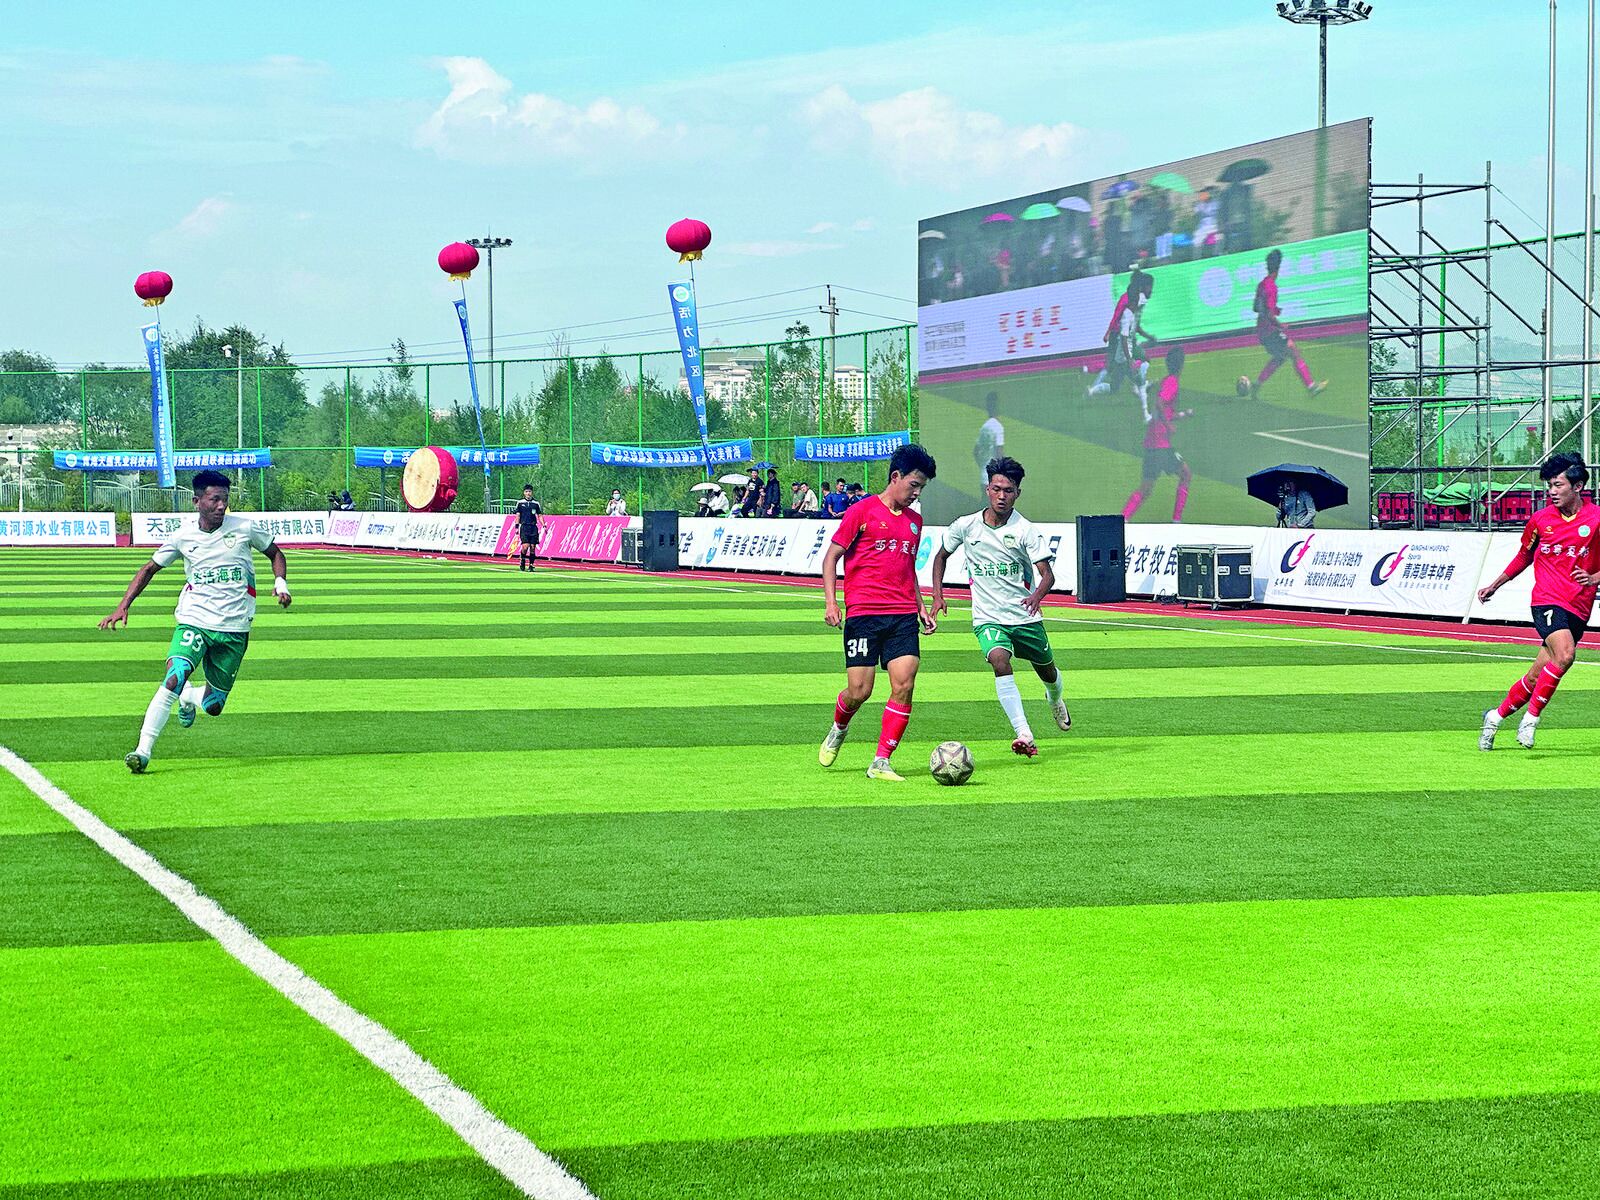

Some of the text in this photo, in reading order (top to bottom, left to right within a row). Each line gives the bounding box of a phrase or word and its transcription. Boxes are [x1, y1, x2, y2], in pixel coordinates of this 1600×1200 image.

[0, 519, 110, 537] 黄河源水业有限公司
[721, 533, 787, 557] 青海省足球协会
[974, 560, 1019, 577] 圣洁海南
[1402, 563, 1456, 581] 青海慧丰体育
[1304, 571, 1357, 588] 流股份有限公司
[1543, 609, 1554, 626] 7
[180, 630, 204, 652] 93
[983, 627, 1001, 641] 17
[847, 638, 869, 658] 34
